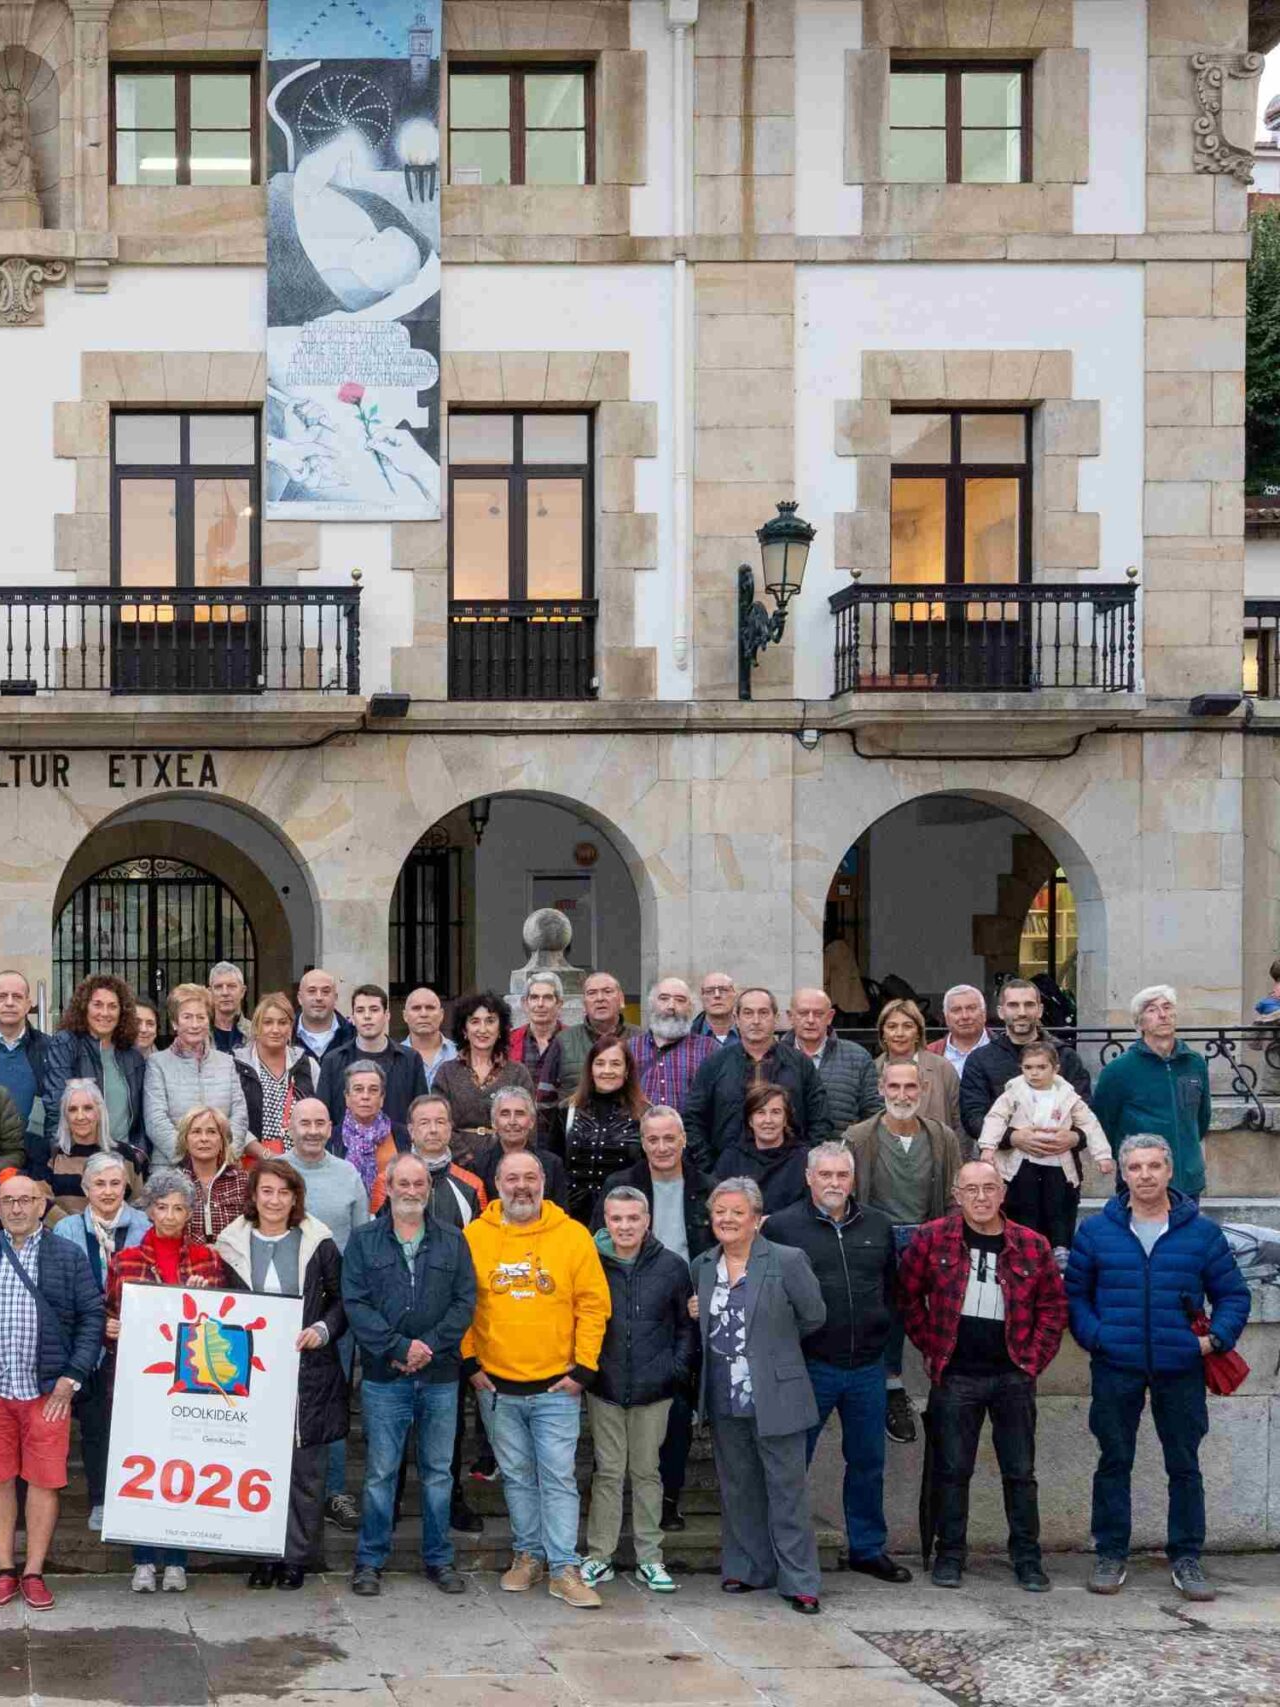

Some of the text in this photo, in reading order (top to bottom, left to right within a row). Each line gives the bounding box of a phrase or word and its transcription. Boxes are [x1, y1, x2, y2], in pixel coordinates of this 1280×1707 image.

[108, 753, 218, 788] ETXEA
[171, 1405, 248, 1423] ODOLKIDEAK
[118, 1454, 273, 1513] 2026
